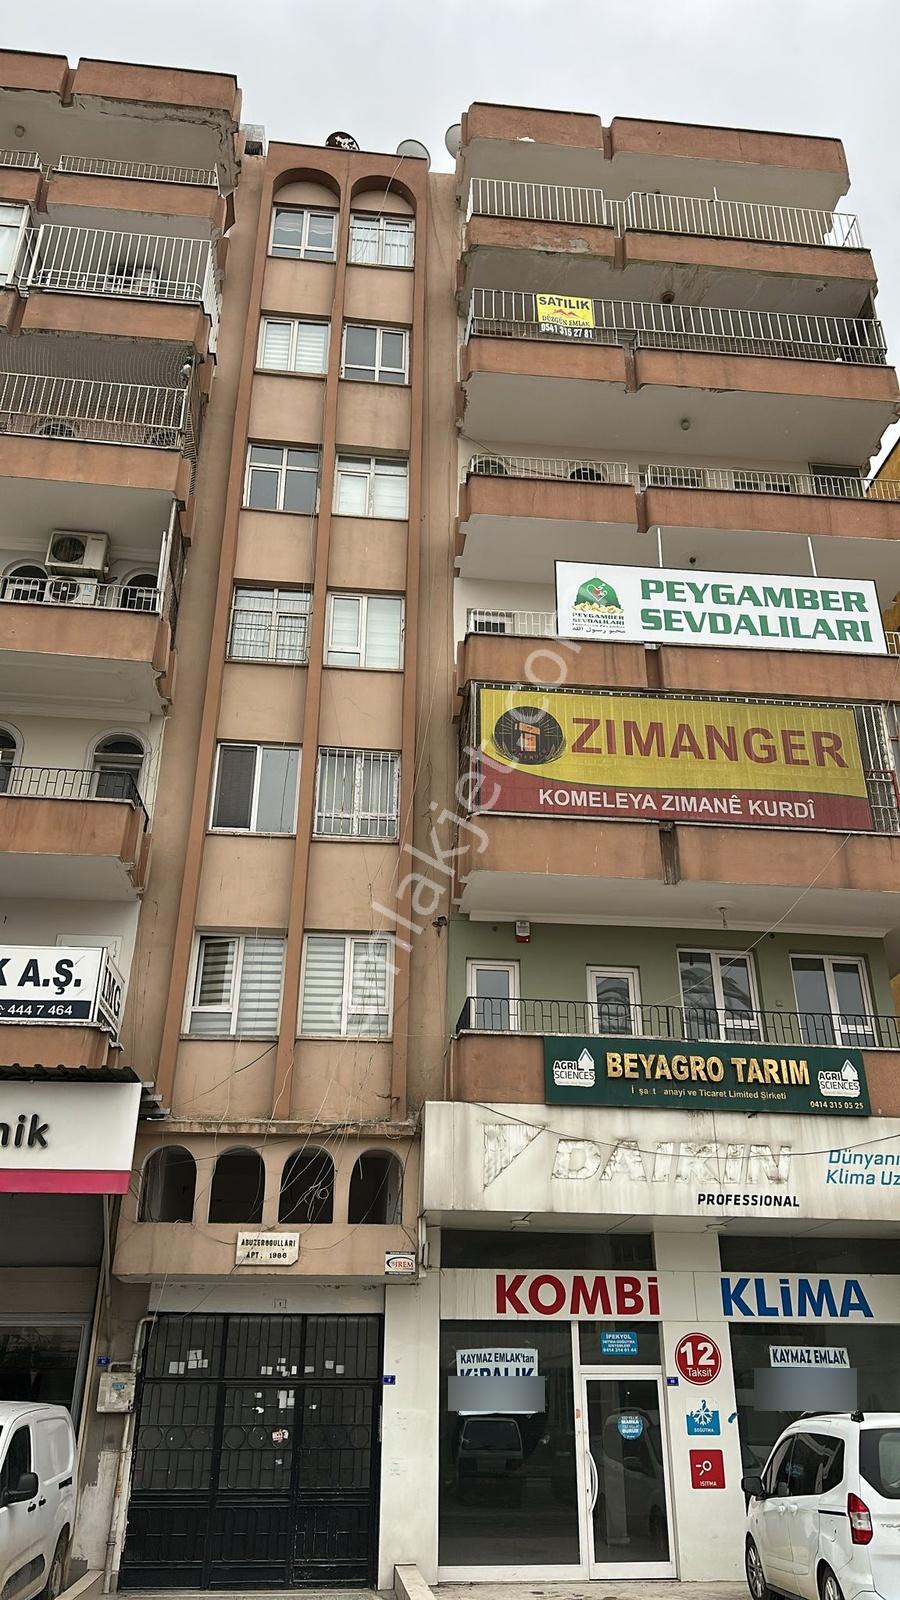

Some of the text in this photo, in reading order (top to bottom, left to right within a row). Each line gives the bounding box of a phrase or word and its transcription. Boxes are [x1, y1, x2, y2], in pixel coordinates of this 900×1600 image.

[538, 296, 590, 310] SATILIK
[541, 323, 593, 339] 0541 315 27 81
[640, 578, 869, 613] PEYGAMBER
[572, 612, 625, 620] PEYGAMBER
[572, 618, 625, 626] SEVDALILARI
[640, 608, 874, 643] SEVDALILARI
[571, 717, 850, 769] ZIMANGER
[538, 789, 816, 819] KOMELEYA ZIMANÊ KURDÎ
[17, 958, 82, 995] A.Ş.
[7, 1004, 73, 1016] 444 7 464
[554, 1061, 577, 1070] AGRI
[606, 1051, 811, 1086] BEYAGRO TARIM
[554, 1070, 595, 1081] SCIENCES
[819, 1072, 842, 1081] AGRI
[819, 1080, 859, 1091] SCIENCES
[699, 1088, 727, 1098] Ticaret
[728, 1090, 759, 1099] Limited
[829, 1101, 843, 1109] 315
[854, 1102, 864, 1110] 25
[826, 1168, 875, 1185] Klima
[697, 1193, 800, 1207] PROFESSIONAL
[245, 1251, 263, 1259] APT.
[460, 1352, 535, 1364] KAYMAZ EMLAK'tan
[680, 1341, 716, 1366] 12
[772, 1348, 847, 1365] KAYMAZ EMLAK
[686, 1367, 713, 1377] Taksit
